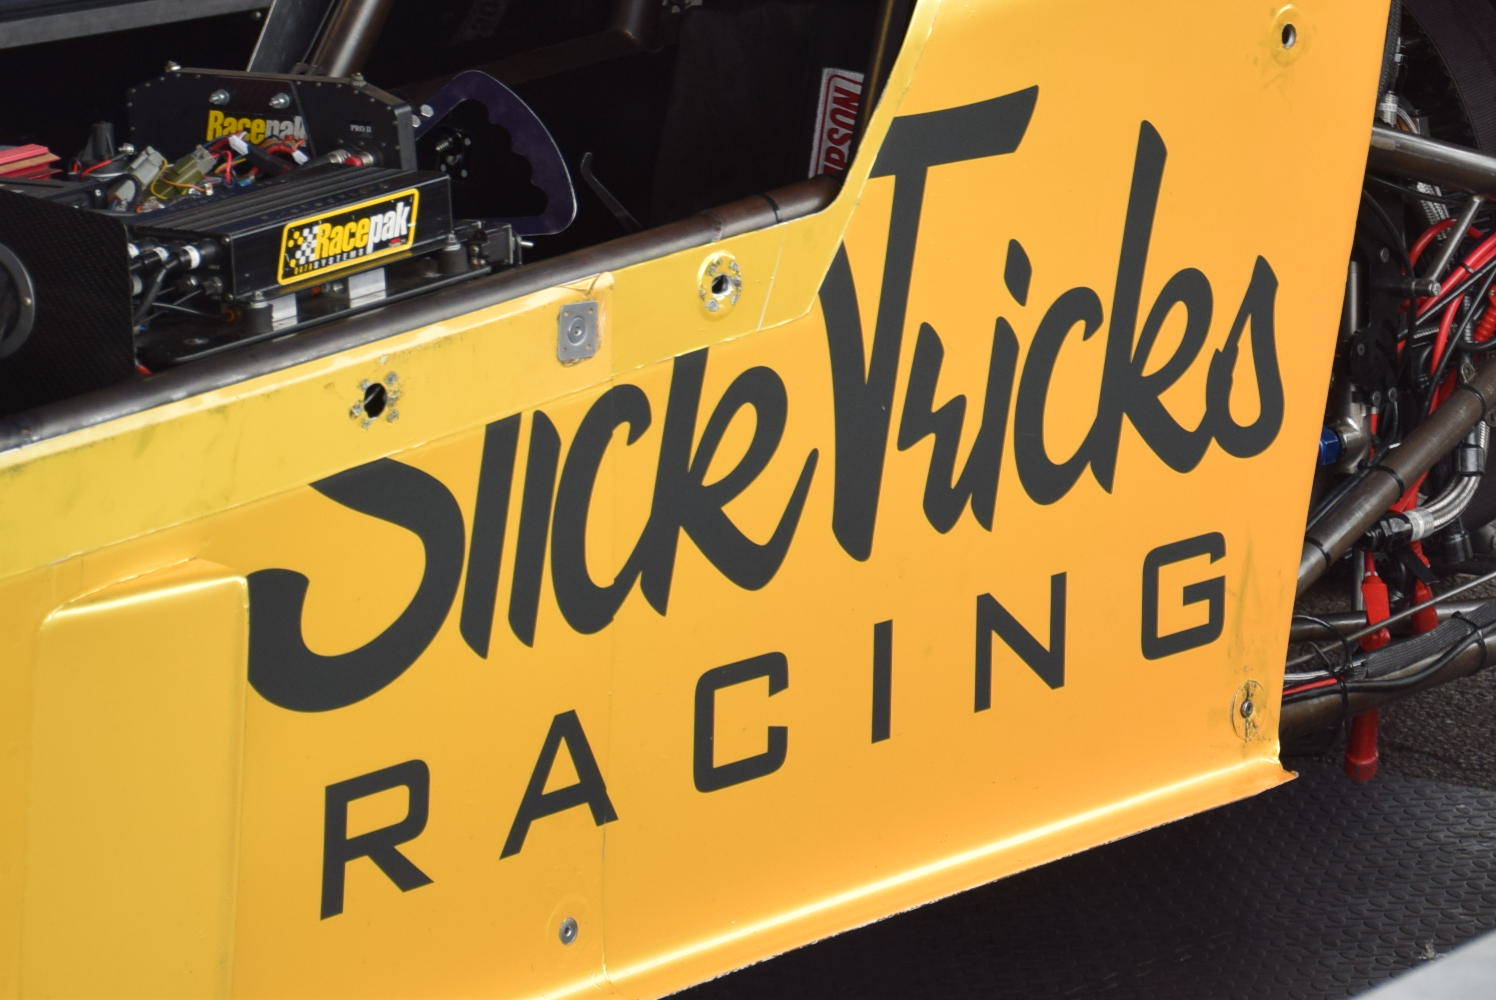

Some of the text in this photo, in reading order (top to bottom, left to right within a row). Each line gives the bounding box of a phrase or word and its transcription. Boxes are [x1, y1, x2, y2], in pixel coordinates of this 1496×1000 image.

[314, 201, 410, 260] Racepak
[314, 249, 364, 270] SYSTEMS
[320, 531, 1225, 920] RACING
